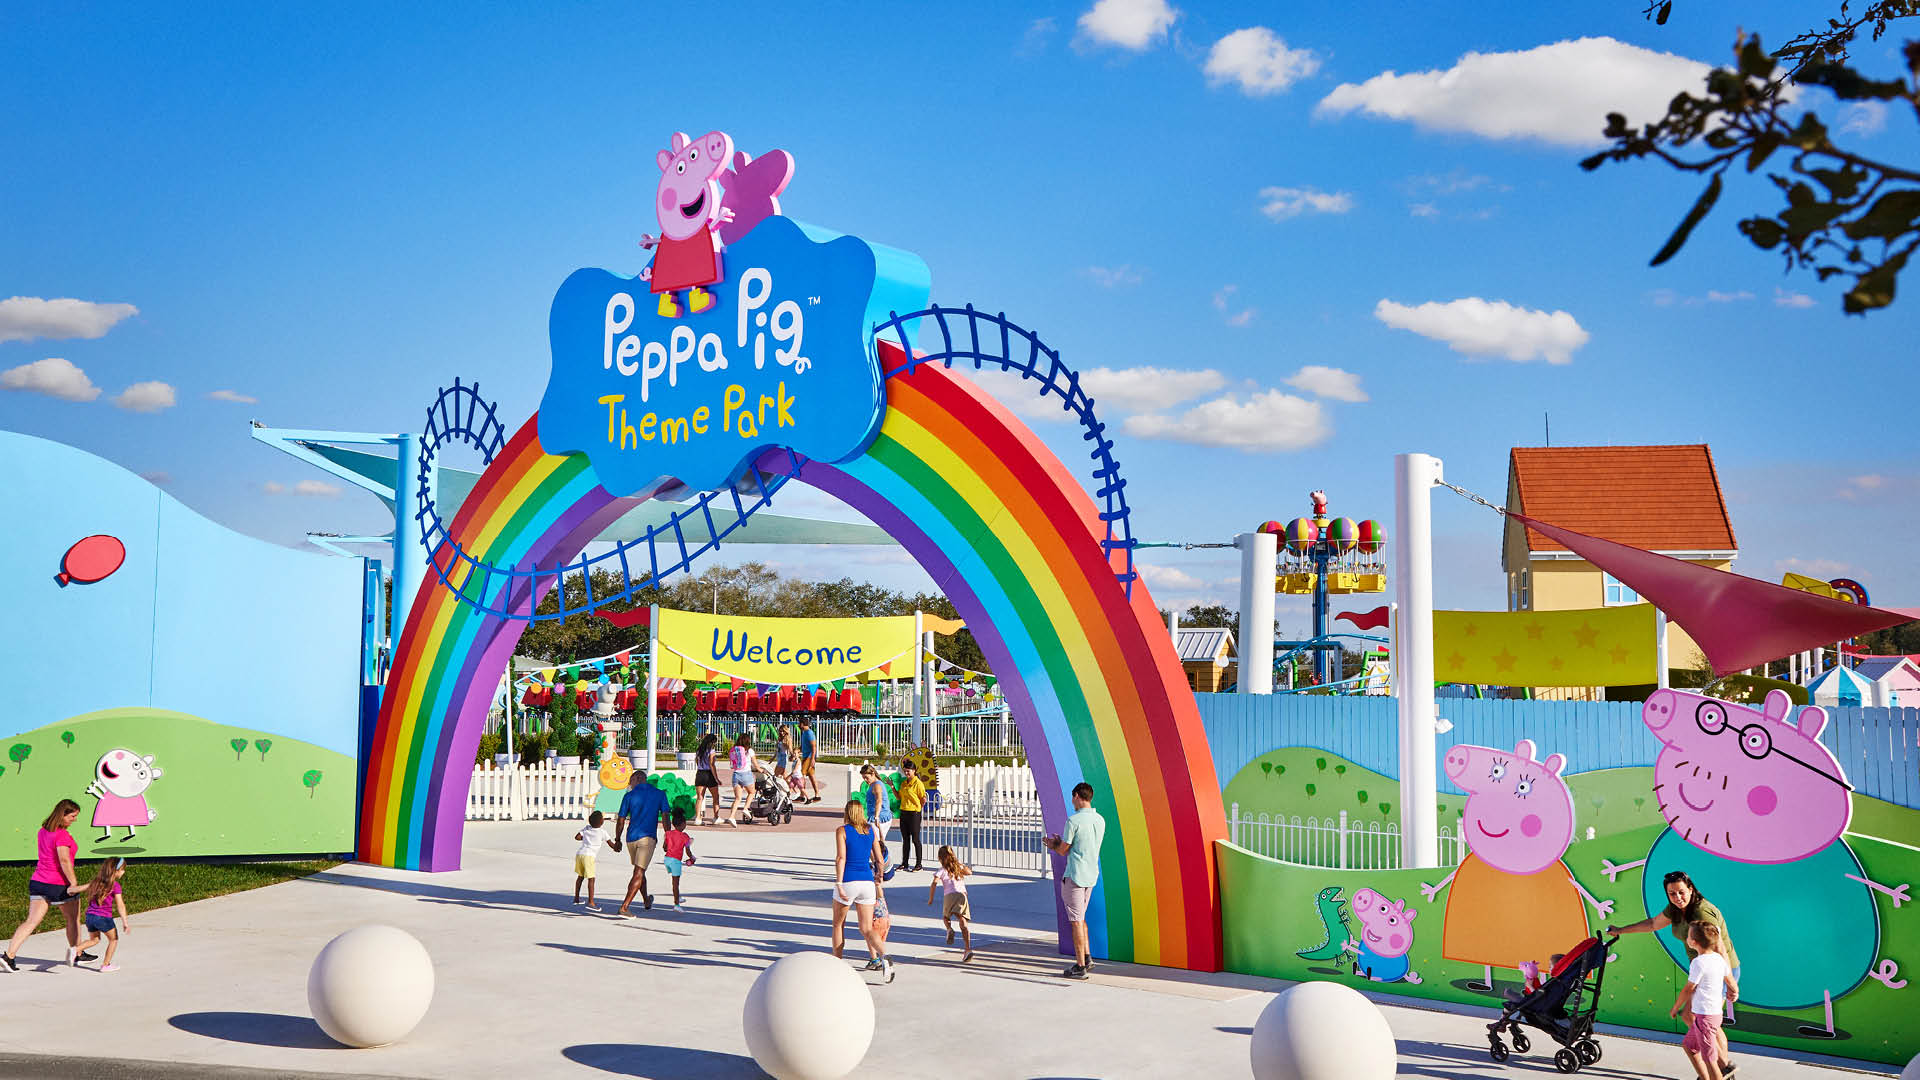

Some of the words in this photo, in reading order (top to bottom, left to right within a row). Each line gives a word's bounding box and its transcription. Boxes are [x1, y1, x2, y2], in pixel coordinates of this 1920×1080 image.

[604, 293, 728, 402] Peppa
[738, 267, 811, 374] Pig
[598, 394, 710, 450] Theme
[724, 381, 795, 438] Park
[711, 628, 862, 665] Welcome
